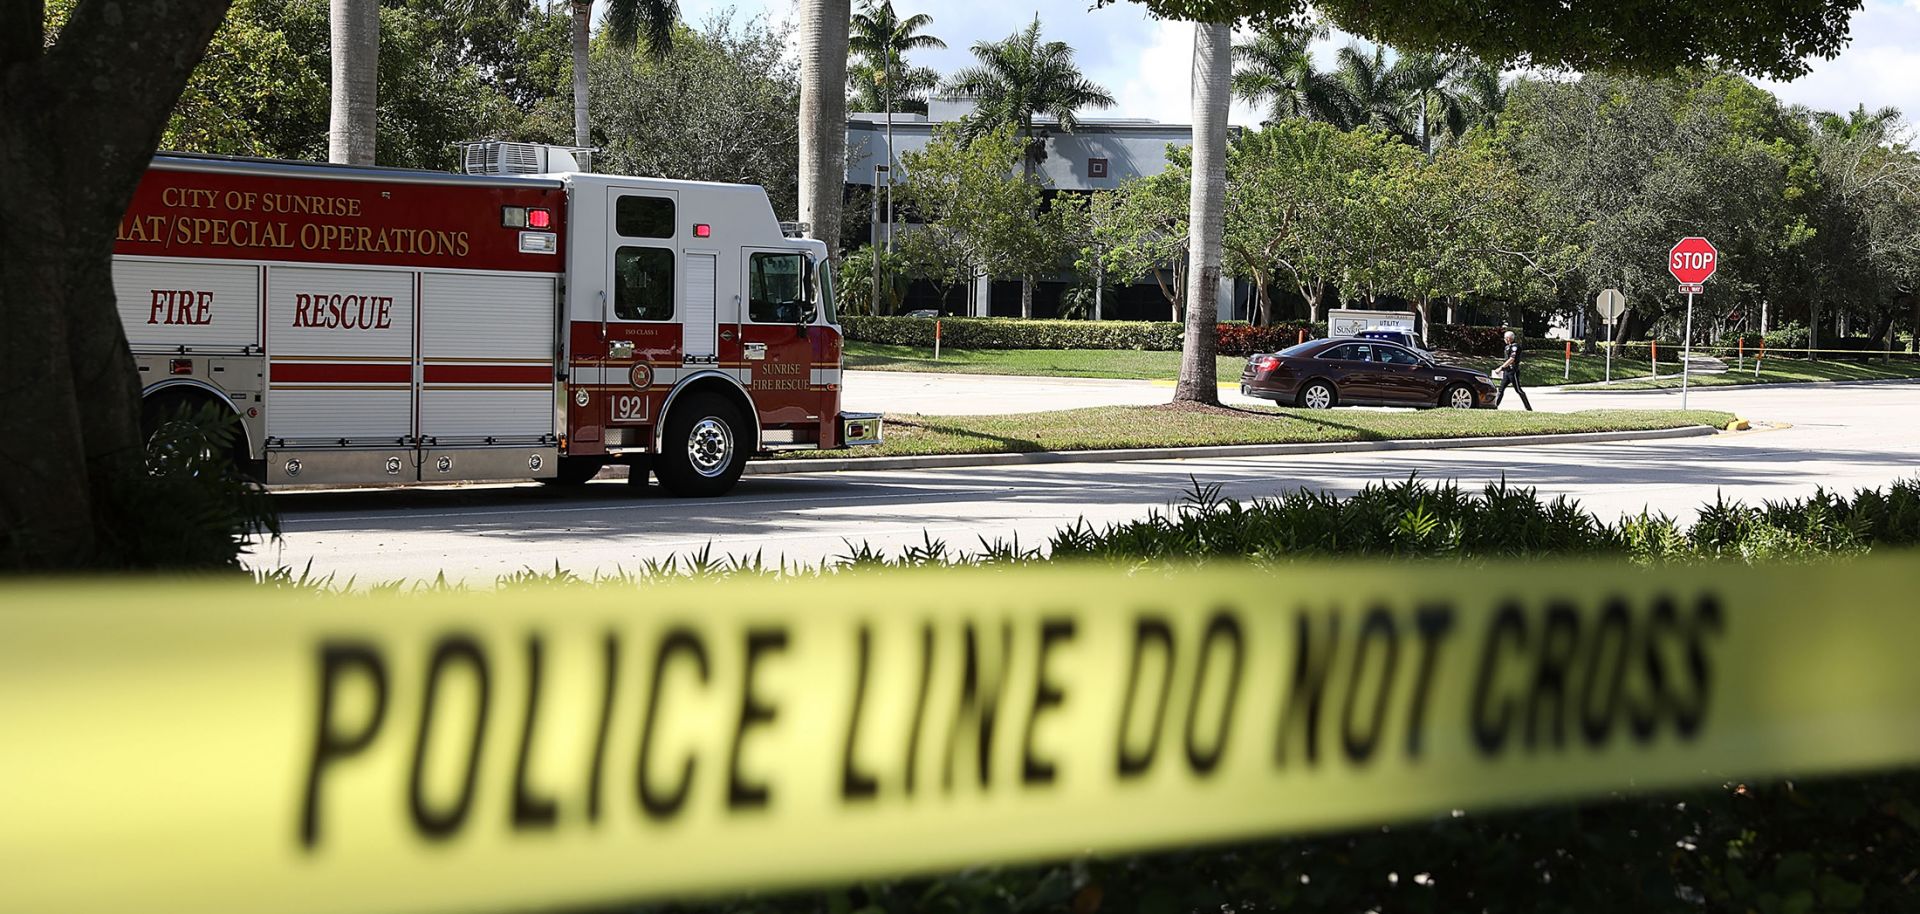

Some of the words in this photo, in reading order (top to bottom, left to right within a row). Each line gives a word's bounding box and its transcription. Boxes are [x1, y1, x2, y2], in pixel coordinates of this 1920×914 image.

[162, 187, 219, 209] CITY
[225, 191, 258, 211] OF
[262, 193, 362, 217] SUNRISE
[300, 222, 470, 257] OPERATIONS
[1672, 252, 1714, 270] STOP
[147, 289, 214, 326] FIRE
[292, 293, 393, 330] RESCUE
[762, 363, 801, 375] SUNRISE
[752, 379, 773, 390] FIRE
[775, 379, 810, 390] RESCUE
[619, 395, 641, 419] 92
[298, 621, 789, 850] POLICE
[841, 616, 1076, 798] LINE
[1116, 606, 1246, 779] DO
[1273, 602, 1457, 770] NOT
[1472, 590, 1727, 758] CROSS
